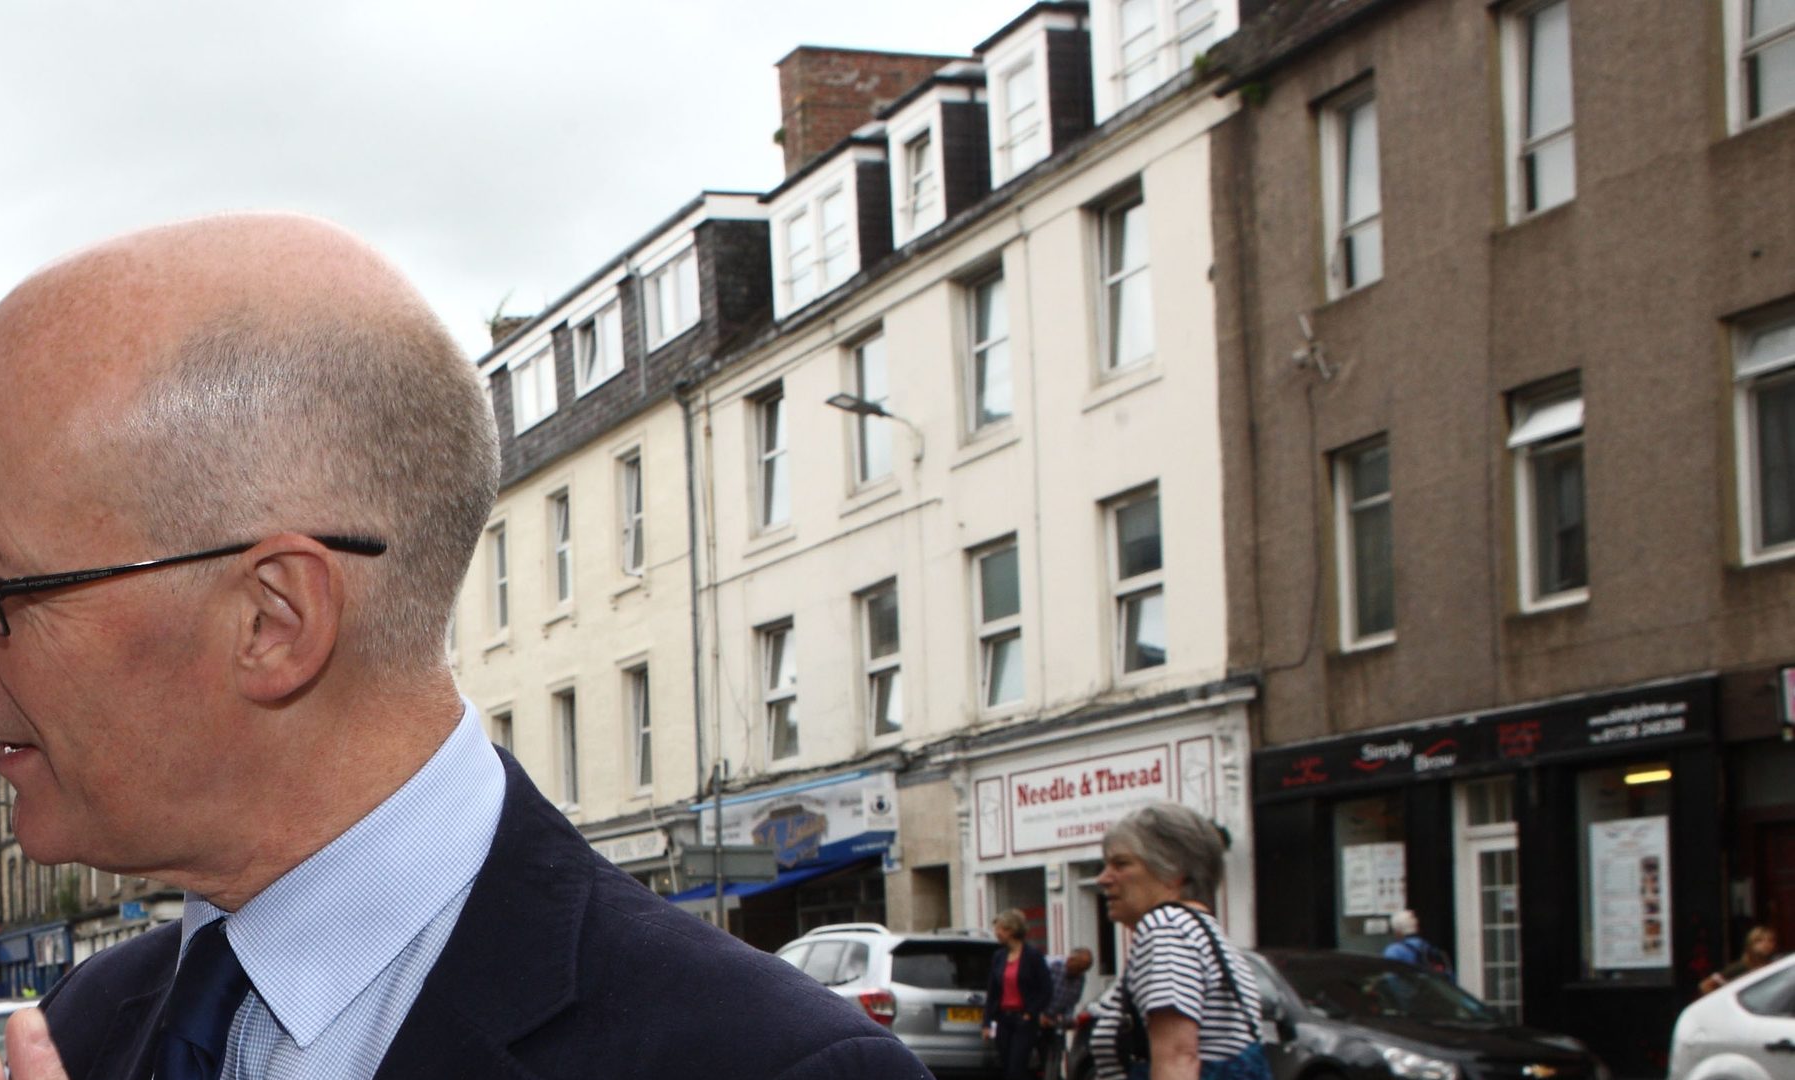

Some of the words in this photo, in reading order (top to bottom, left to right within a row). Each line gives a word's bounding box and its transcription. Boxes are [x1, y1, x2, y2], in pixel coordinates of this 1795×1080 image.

[1361, 739, 1413, 762] Simply
[1414, 753, 1457, 773] Brow
[1017, 776, 1076, 807] Needle
[1080, 772, 1093, 797] &
[1094, 758, 1163, 795] Thread
